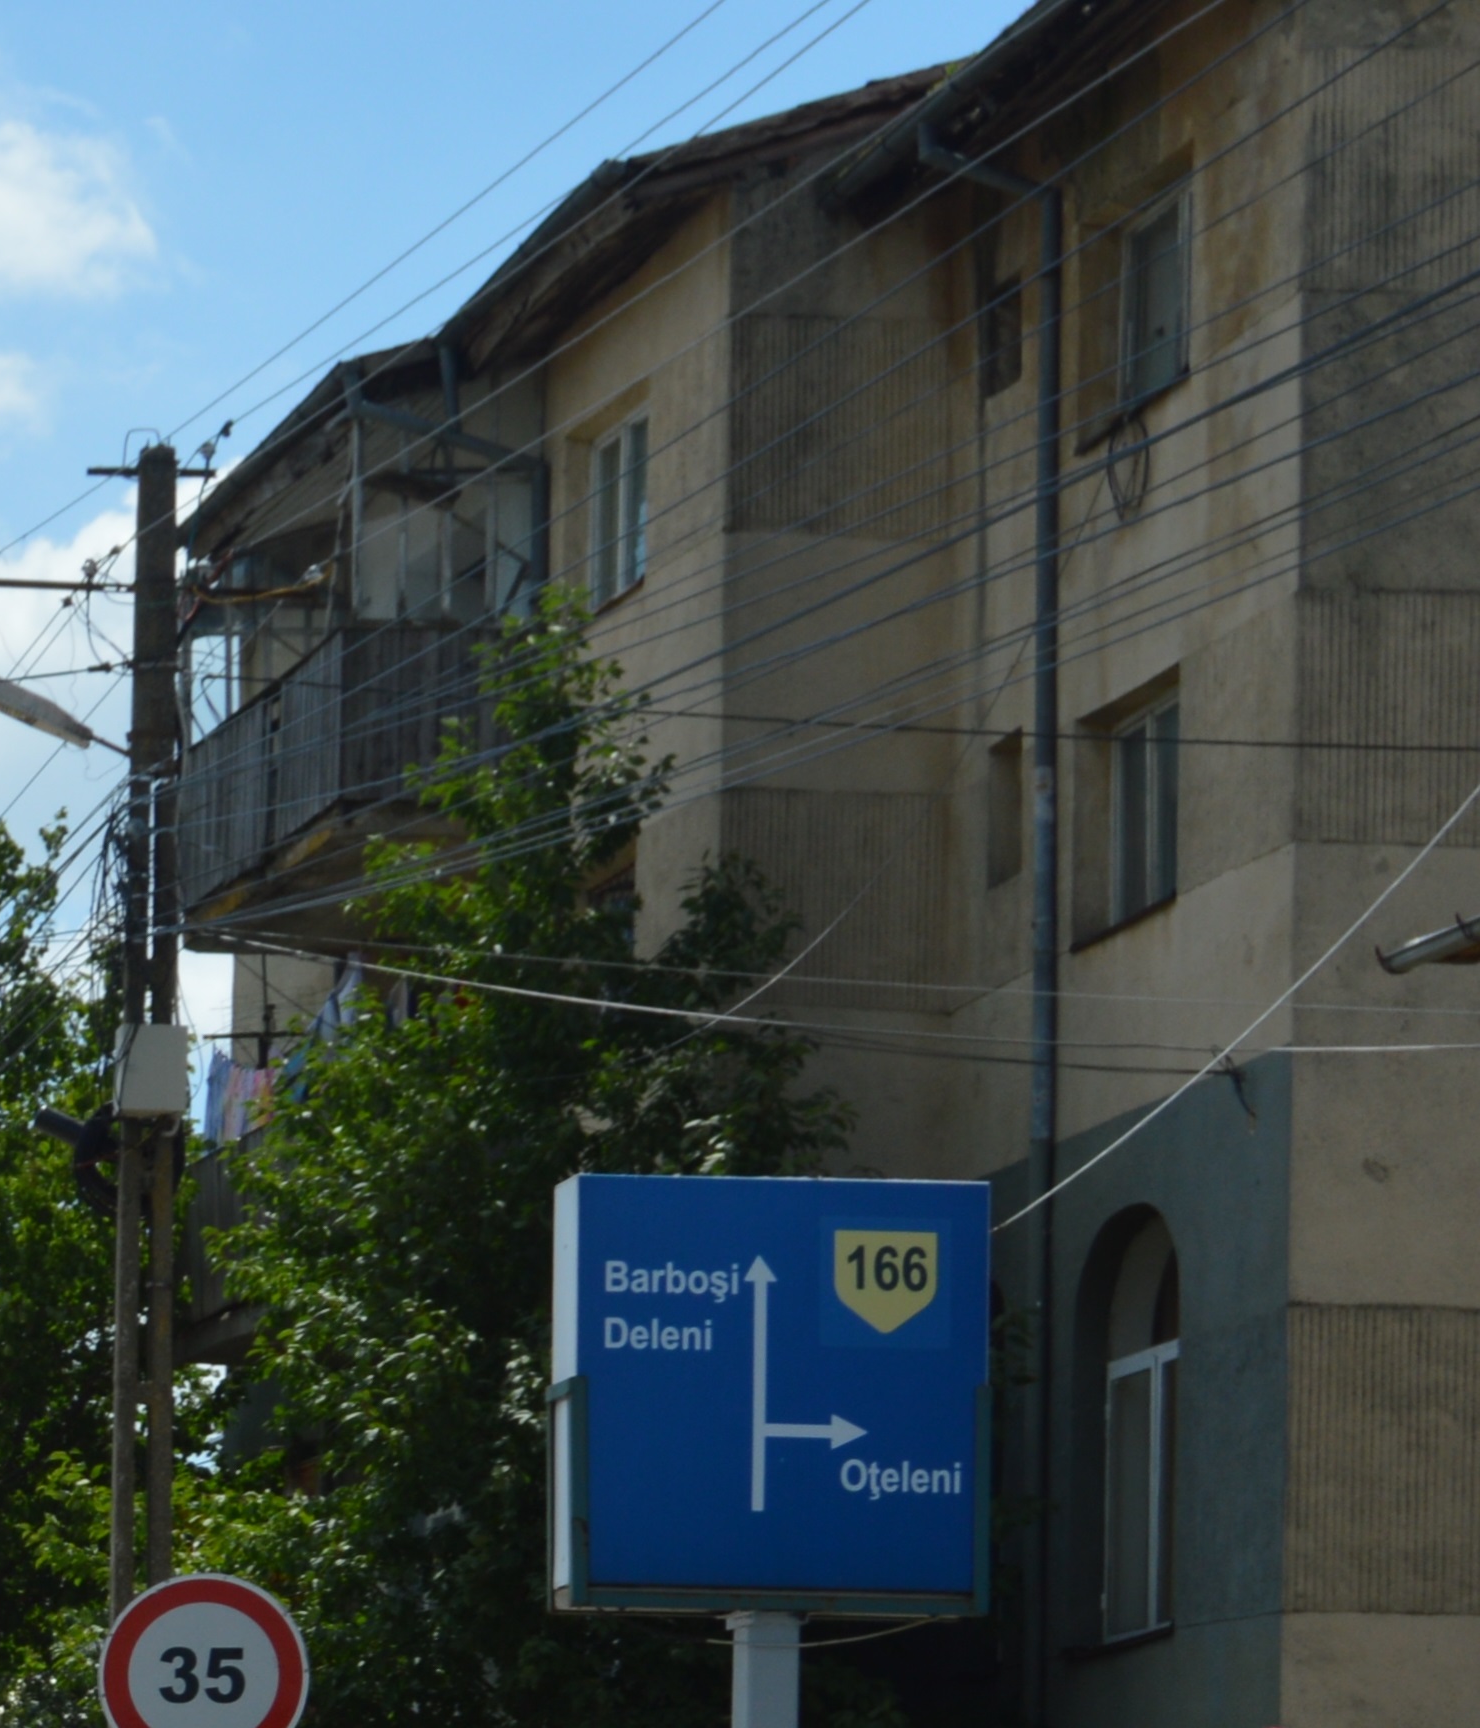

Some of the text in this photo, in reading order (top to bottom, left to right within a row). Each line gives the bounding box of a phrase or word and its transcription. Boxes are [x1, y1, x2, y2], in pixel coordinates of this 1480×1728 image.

[605, 1260, 739, 1303] Barboşi
[847, 1245, 928, 1292] 166
[604, 1317, 712, 1351] Deleni
[840, 1458, 961, 1500] Oţeleni
[158, 1646, 246, 1704] 35
